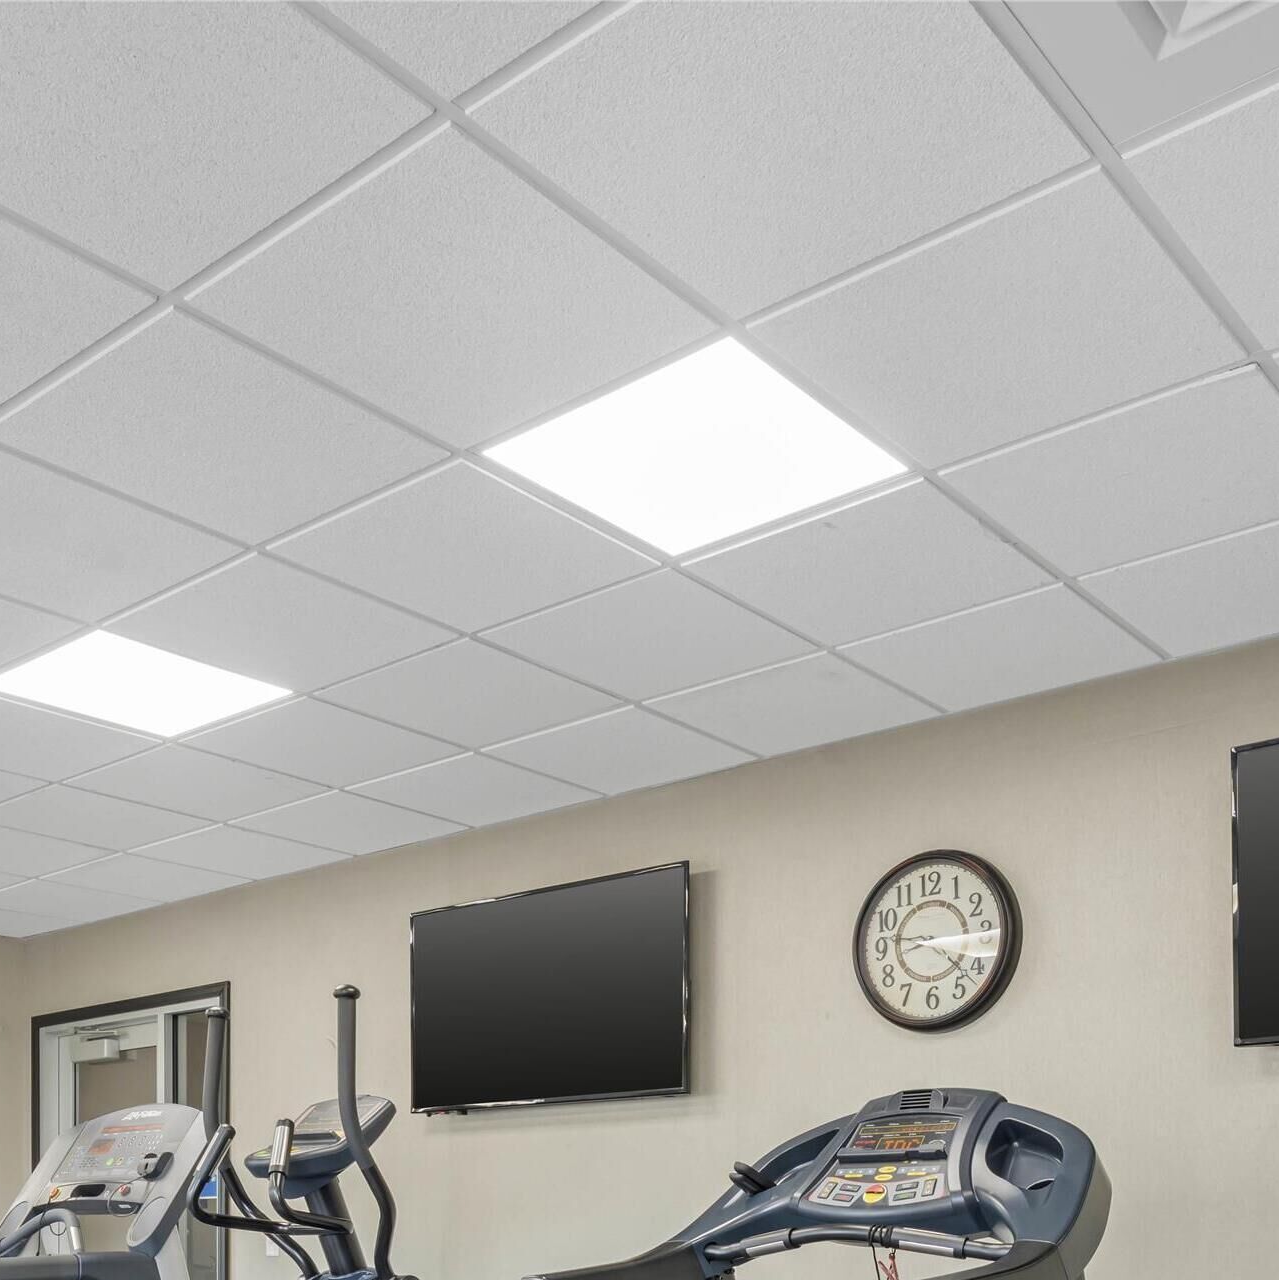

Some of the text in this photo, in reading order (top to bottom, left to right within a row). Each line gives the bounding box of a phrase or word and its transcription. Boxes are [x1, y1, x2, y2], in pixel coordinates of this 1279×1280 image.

[896, 882, 913, 908] 11
[919, 871, 942, 897] 12
[951, 875, 961, 900] 1
[969, 892, 983, 917] 2
[877, 908, 897, 933] 10
[979, 920, 992, 944] 3
[875, 937, 888, 961] 9
[882, 964, 895, 988] 8
[971, 957, 985, 975] 4
[899, 983, 912, 1007] 7
[926, 986, 940, 1010] 6
[952, 974, 966, 1000] 5
